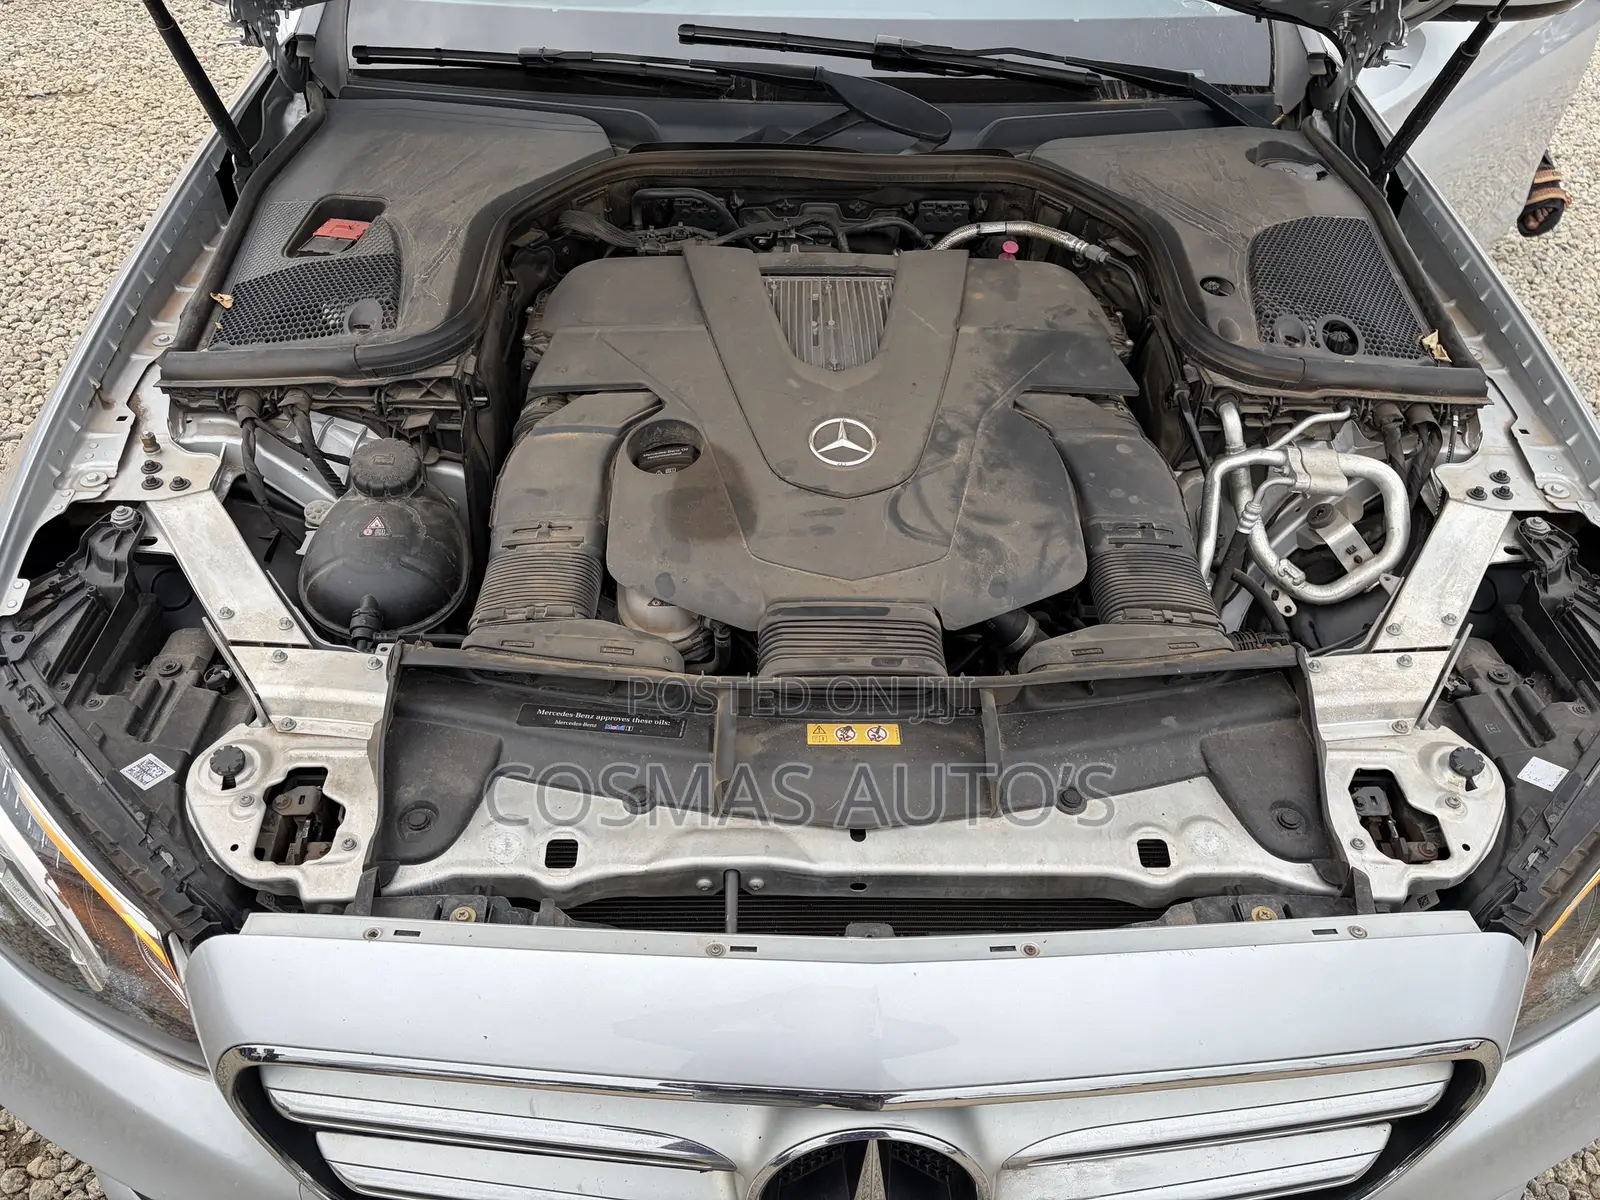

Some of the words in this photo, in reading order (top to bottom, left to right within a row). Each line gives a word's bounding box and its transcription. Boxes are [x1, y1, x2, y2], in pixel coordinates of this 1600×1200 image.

[536, 708, 595, 719] Mercedes-Benz
[595, 714, 631, 723] approves
[632, 717, 653, 725] these
